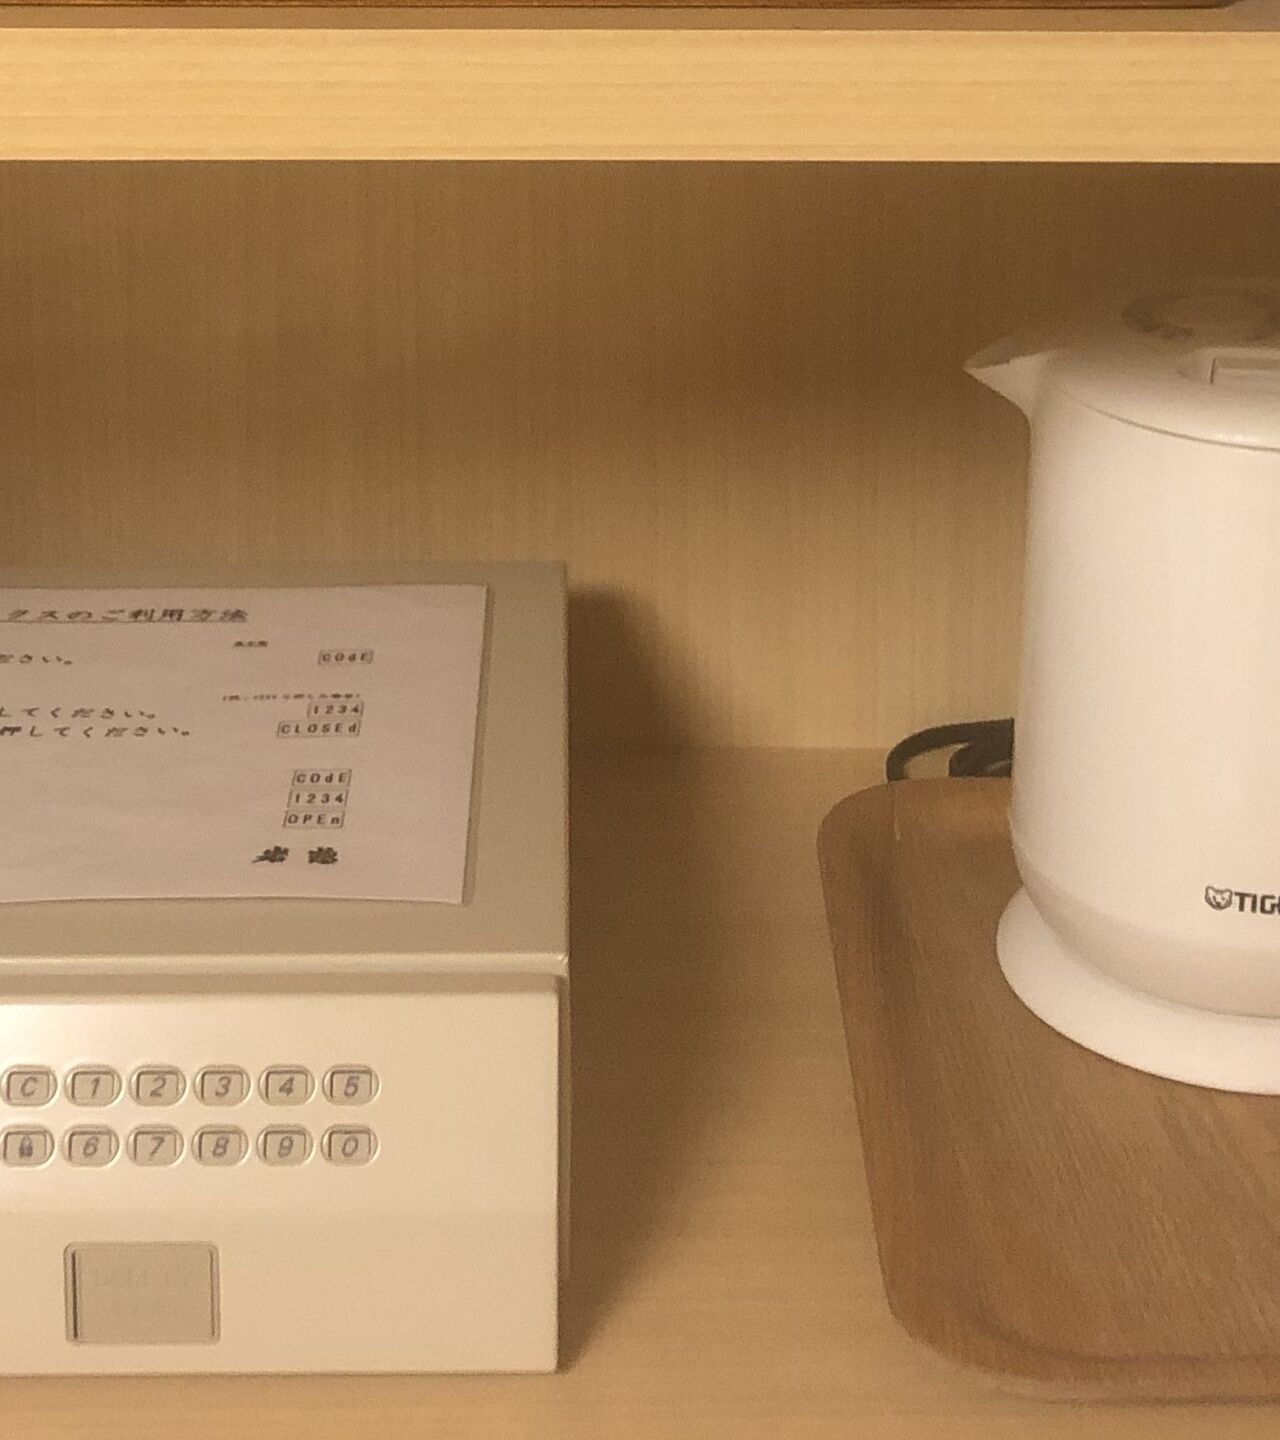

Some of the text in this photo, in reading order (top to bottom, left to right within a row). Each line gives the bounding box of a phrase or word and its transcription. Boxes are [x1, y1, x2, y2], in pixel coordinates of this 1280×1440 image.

[293, 792, 345, 804] 1234
[21, 1076, 359, 1098] C 1 2 3 4 5
[82, 1136, 358, 1158] 6 7 8 9 0
